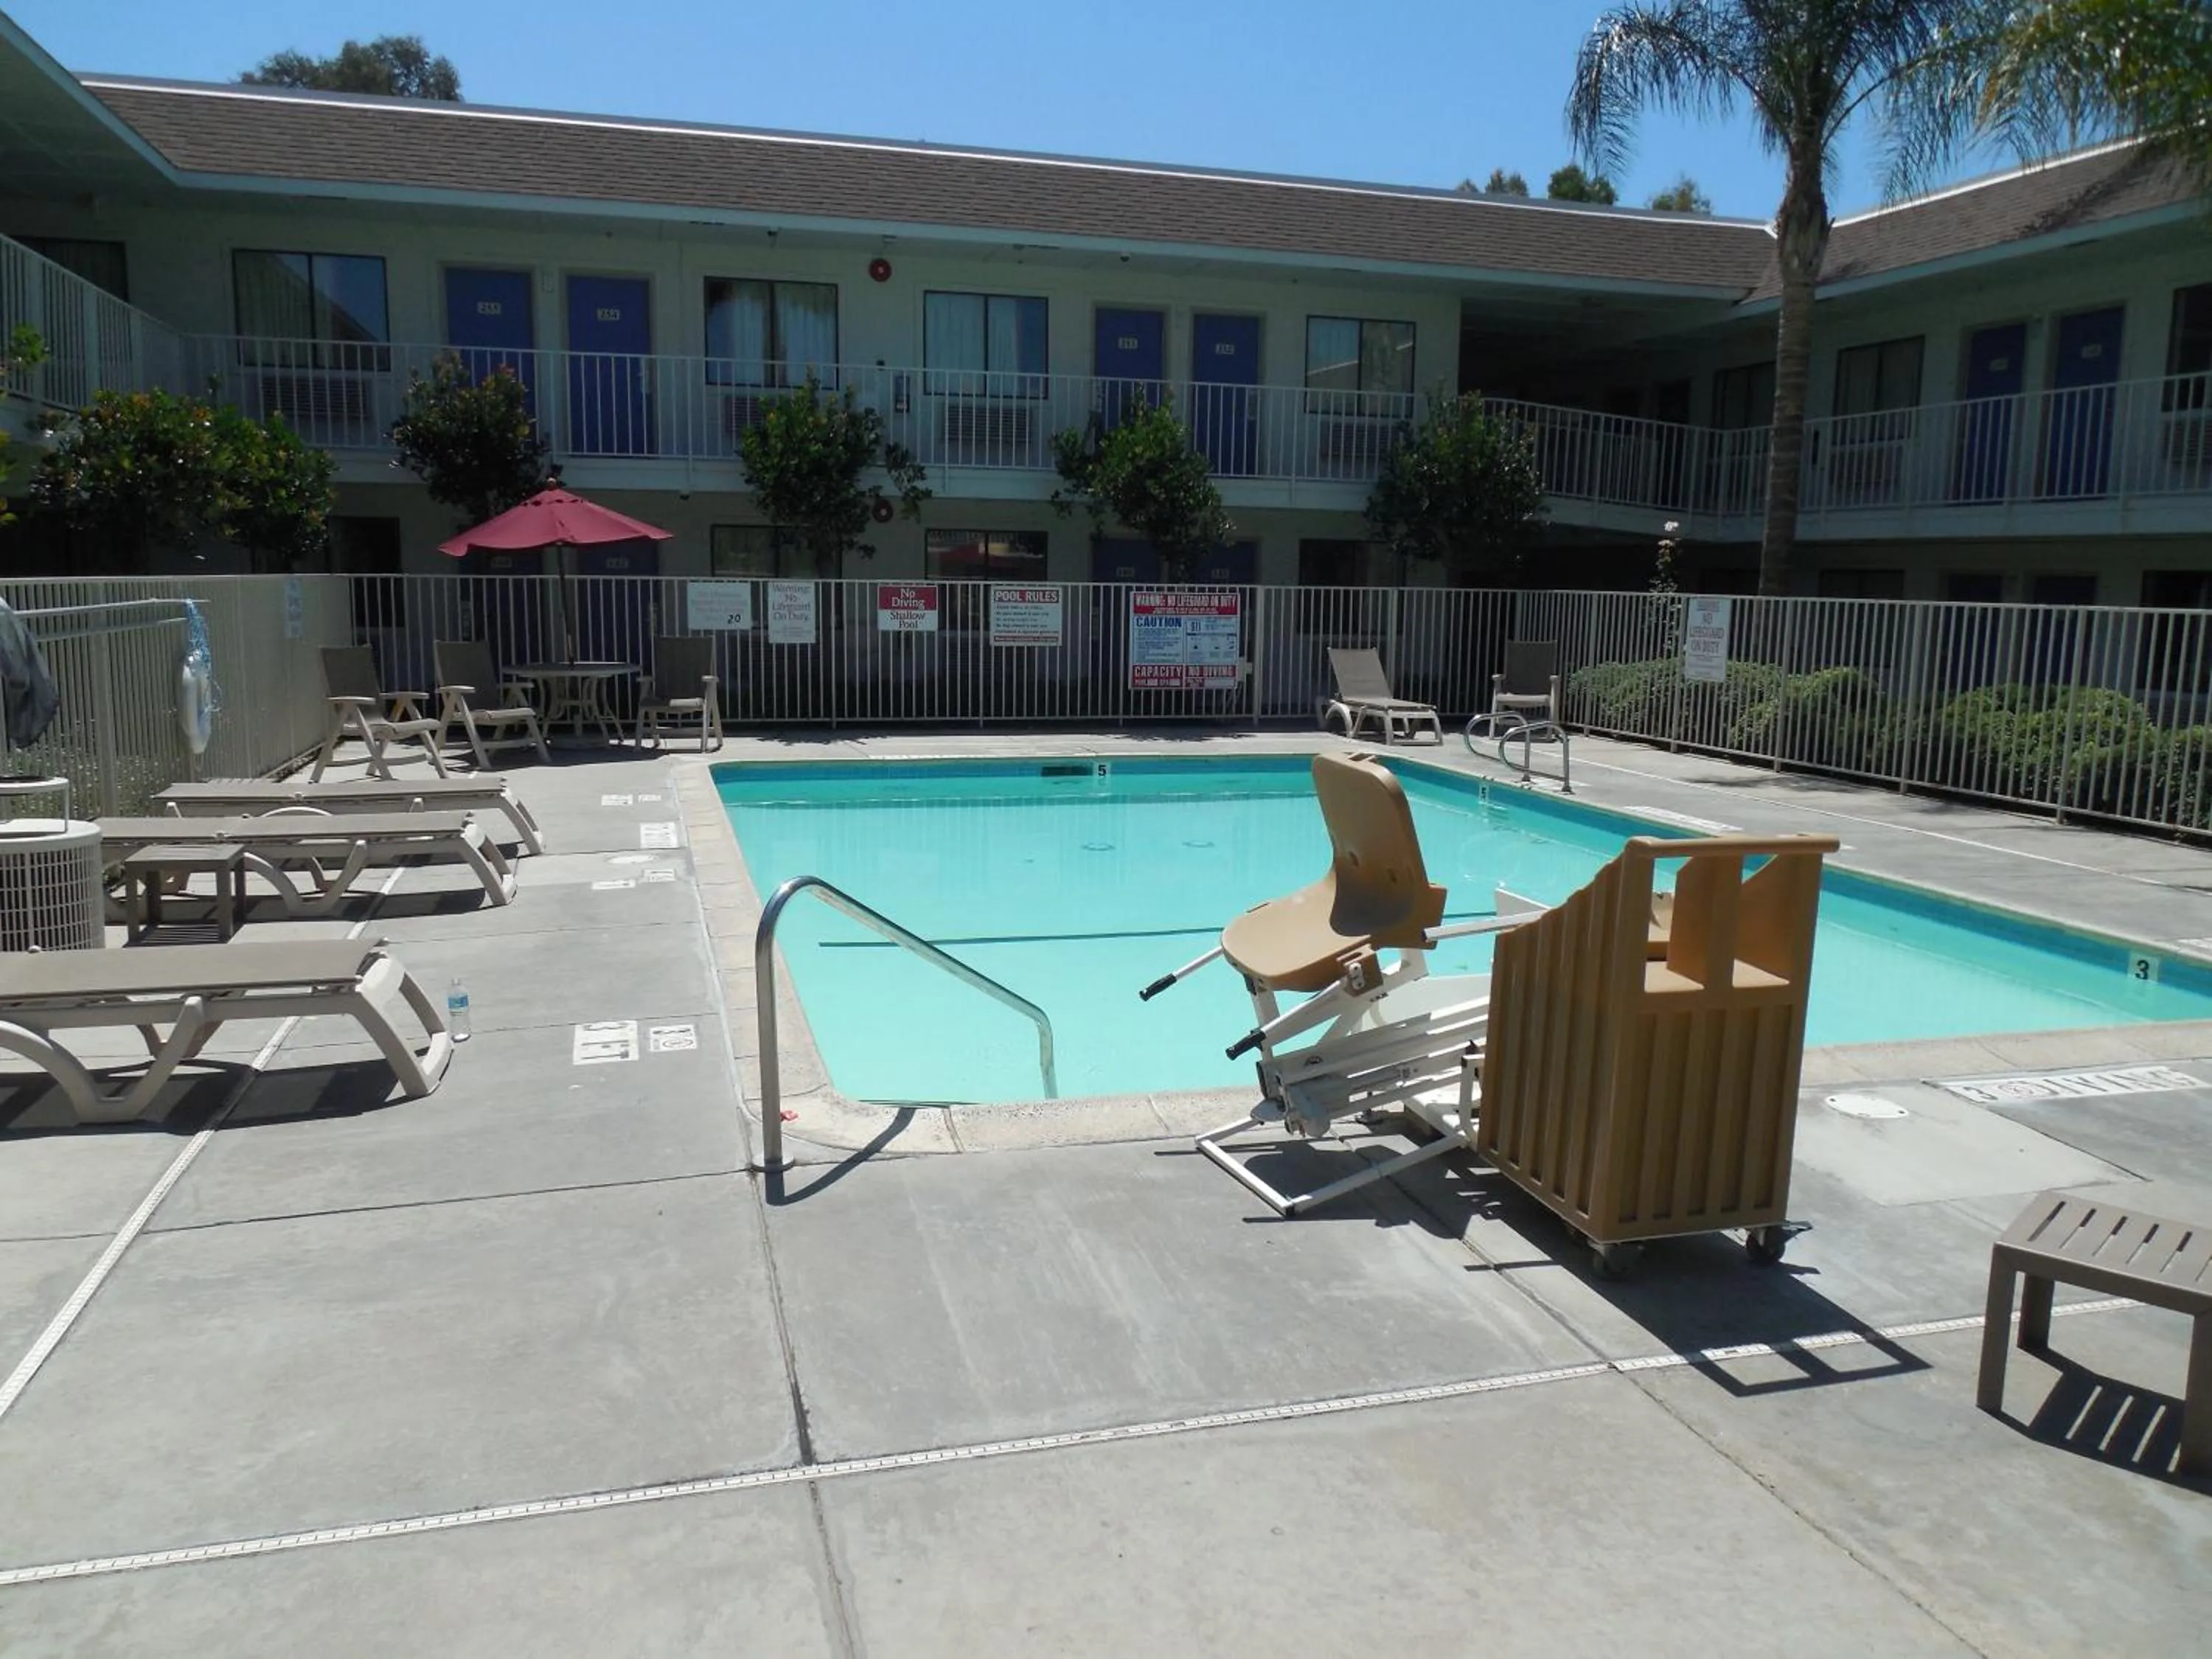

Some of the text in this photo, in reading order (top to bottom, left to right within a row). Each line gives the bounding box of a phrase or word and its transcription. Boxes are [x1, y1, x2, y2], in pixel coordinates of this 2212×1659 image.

[900, 588, 916, 598] No
[995, 591, 1058, 602] POOL RULES
[891, 596, 926, 610] Diving
[773, 611, 787, 620] On
[890, 610, 926, 620] Shallow
[899, 619, 919, 629] Pool
[1136, 616, 1182, 627] CAUTION
[1135, 666, 1182, 678] CAPACITY
[1188, 666, 1200, 677] NO
[1097, 765, 1107, 776] 5
[2135, 959, 2150, 981] 3
[1962, 1086, 1999, 1102] 3
